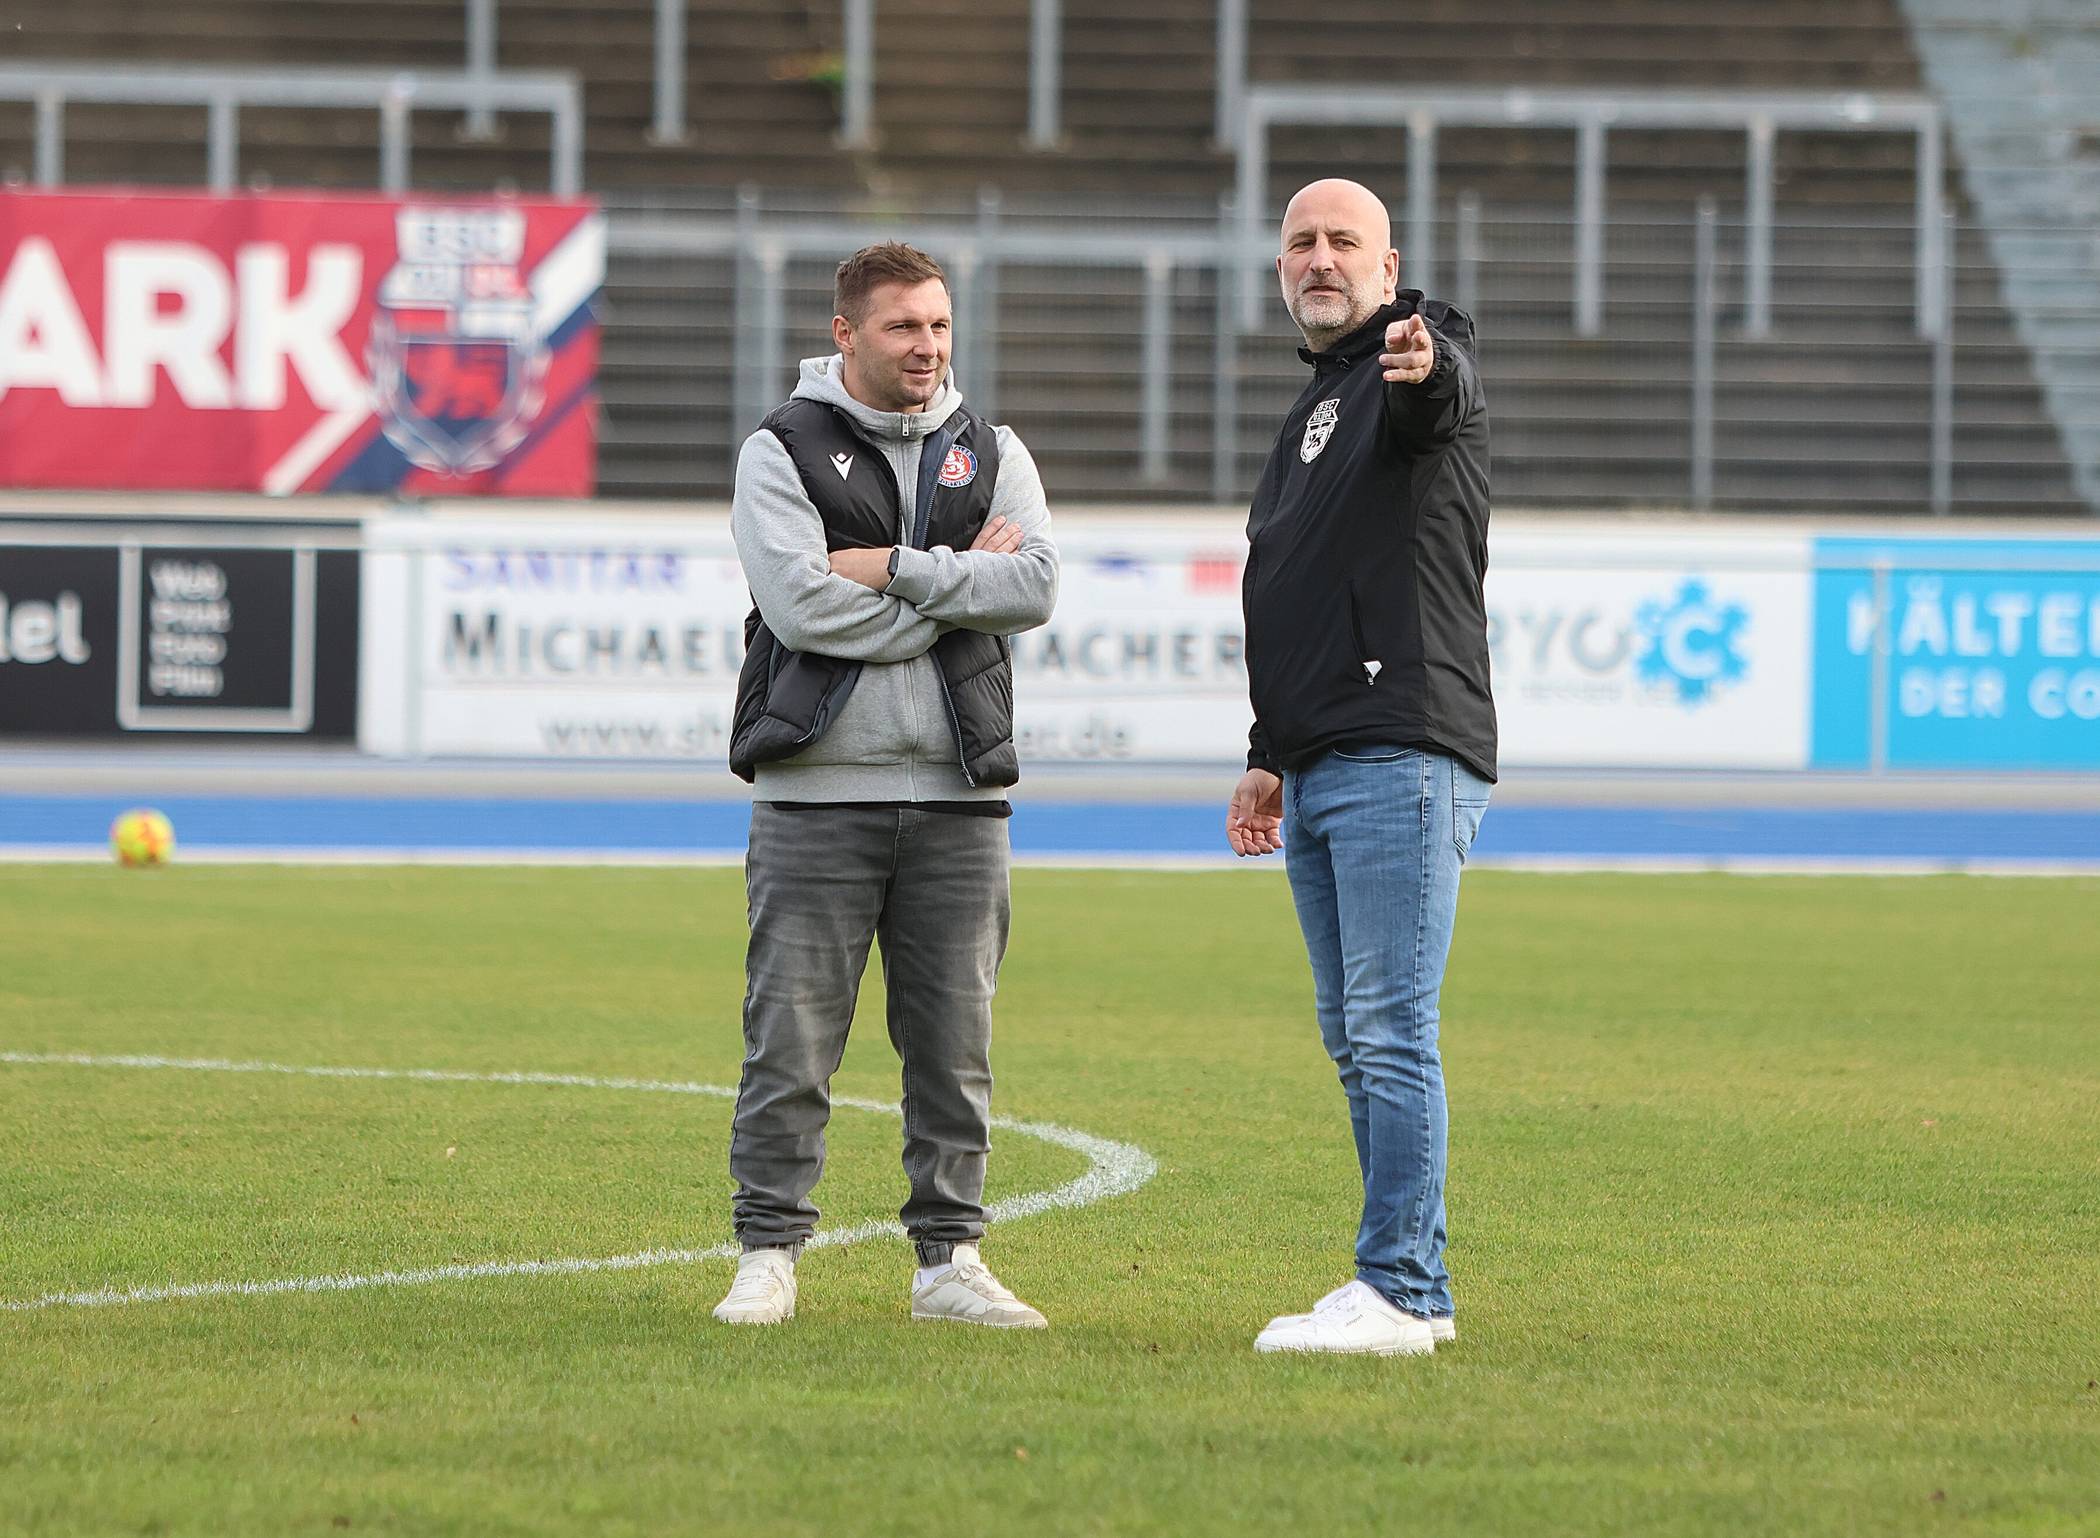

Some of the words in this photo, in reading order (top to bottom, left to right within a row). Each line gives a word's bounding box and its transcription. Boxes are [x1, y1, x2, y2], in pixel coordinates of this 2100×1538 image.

[0, 236, 368, 411] ARK
[1899, 667, 2007, 719] DER
[1013, 709, 1134, 757] er.de
